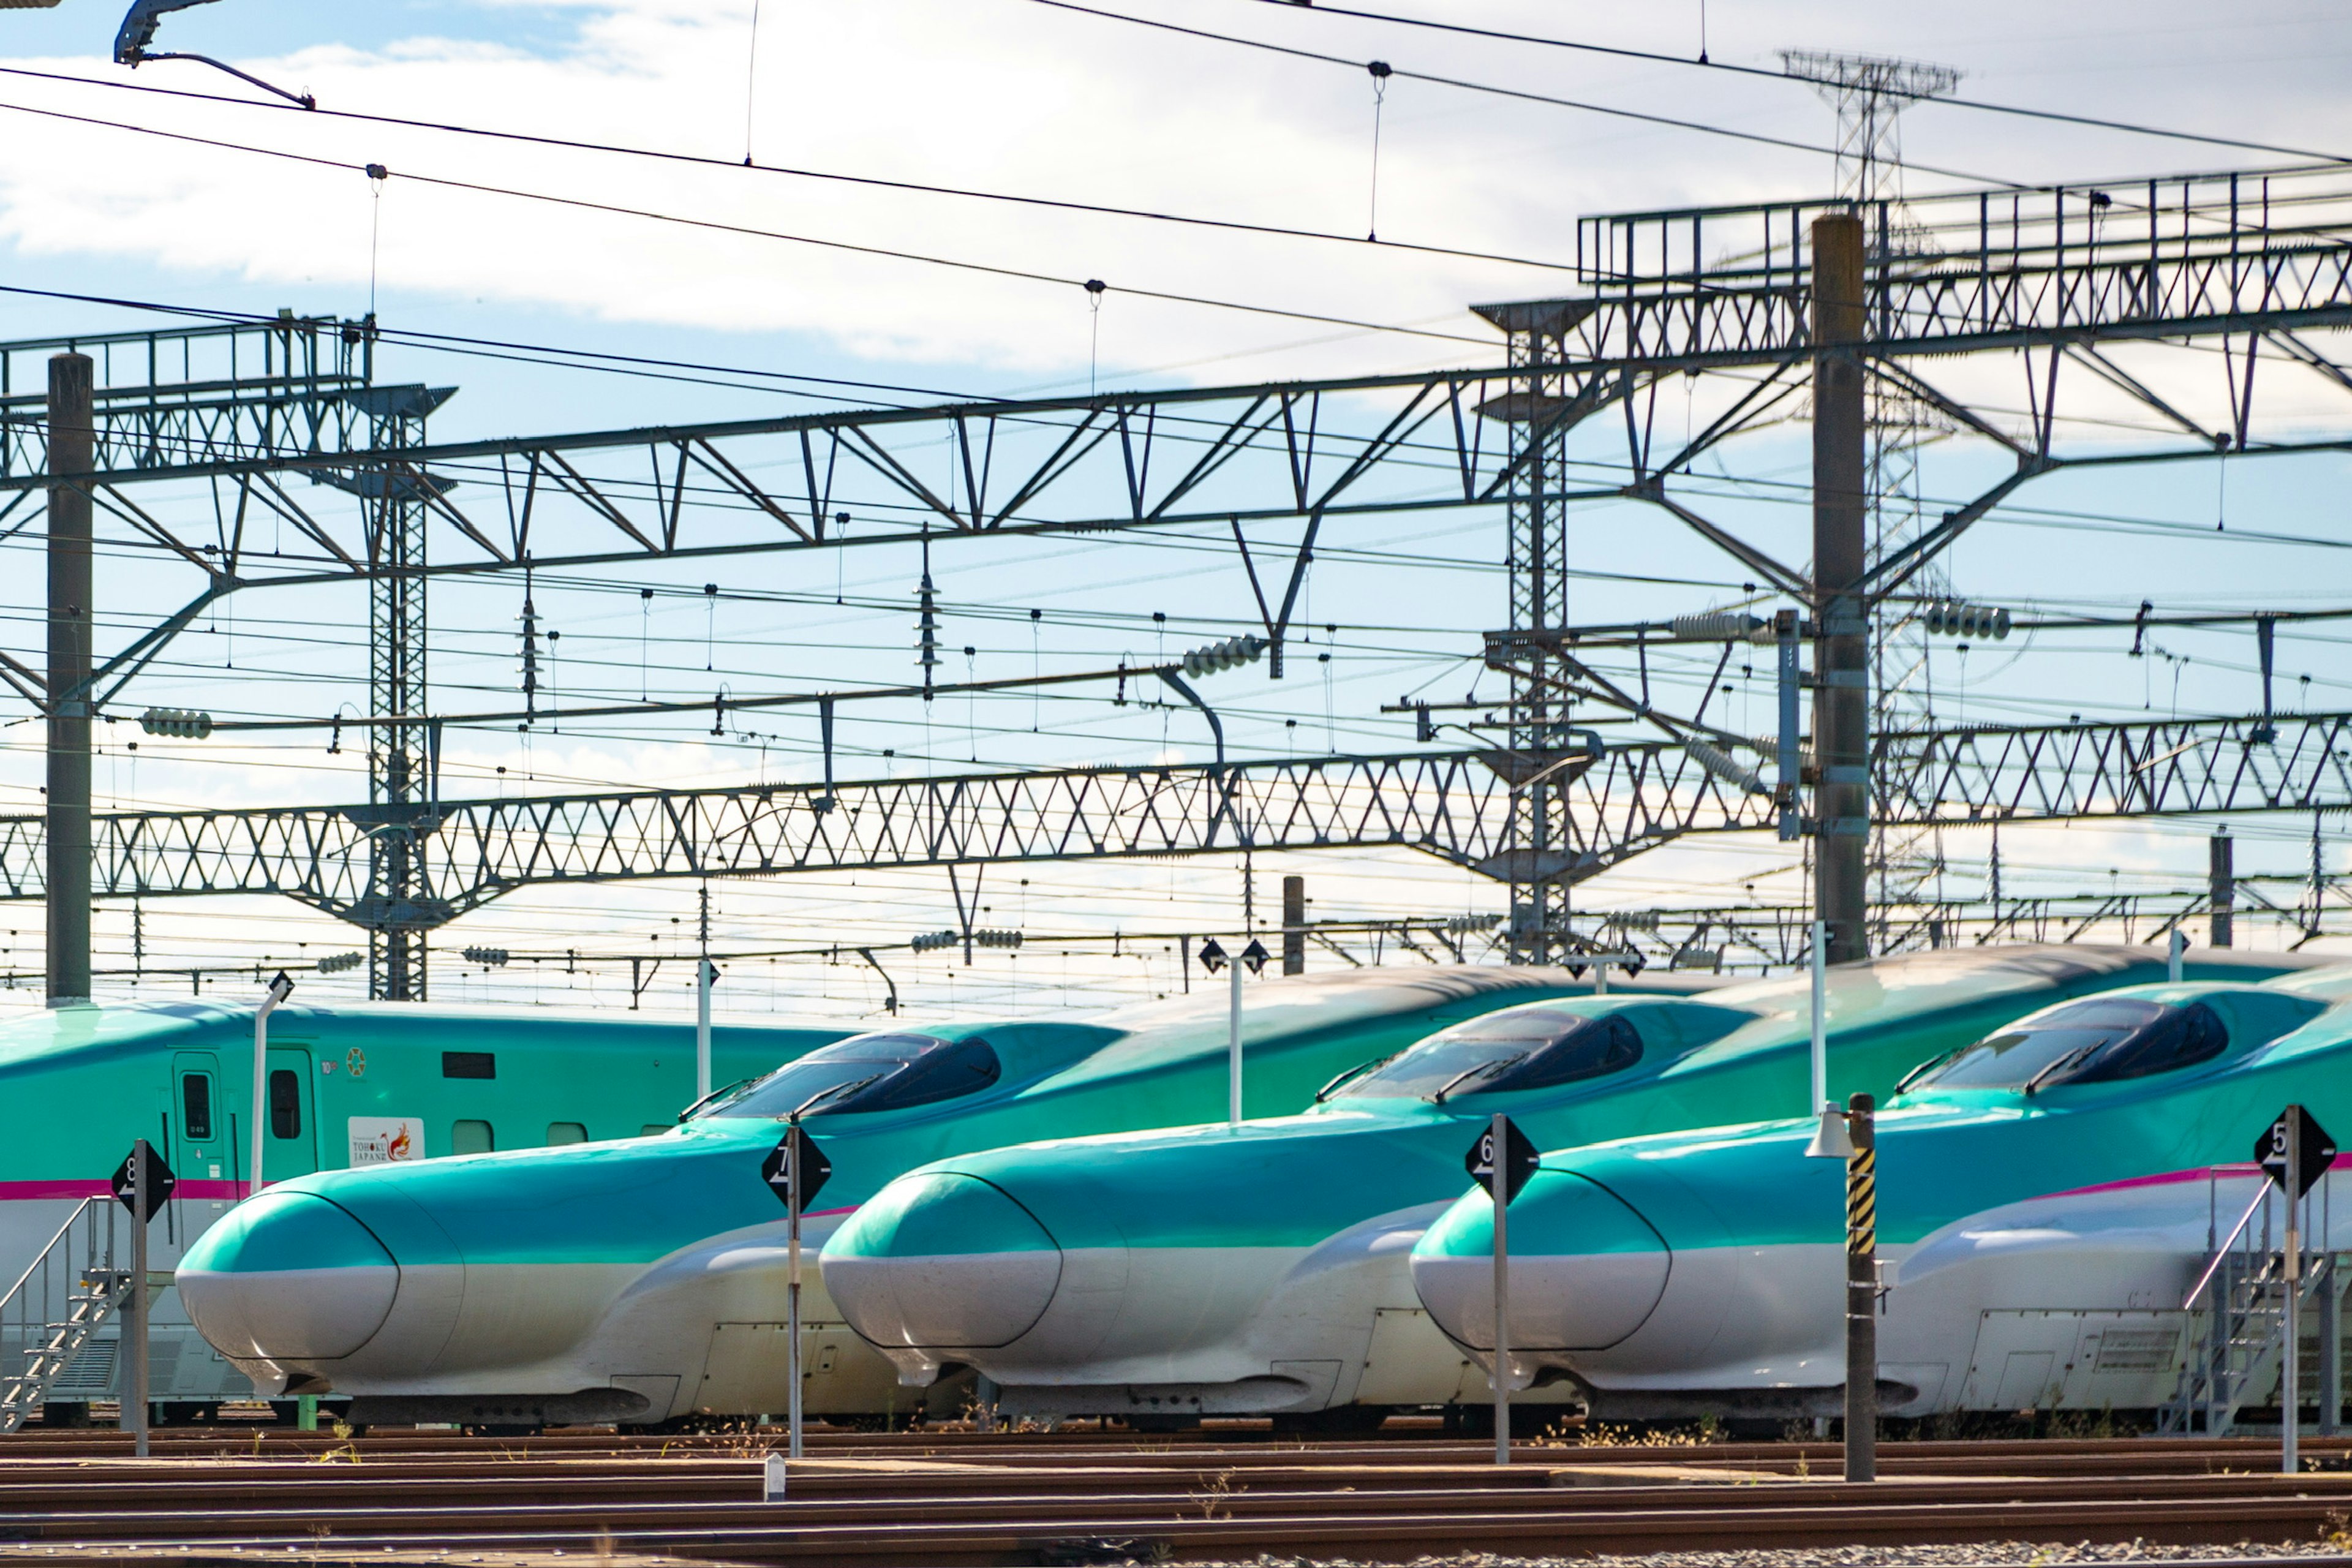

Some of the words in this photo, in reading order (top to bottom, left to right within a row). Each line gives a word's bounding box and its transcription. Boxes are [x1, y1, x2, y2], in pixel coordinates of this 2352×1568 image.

[353, 1142, 386, 1152] TOHOKU
[1482, 1135, 1493, 1162] 6
[2273, 1123, 2286, 1152] 5
[353, 1152, 381, 1161] JAPAN
[777, 1147, 788, 1171] 7
[127, 1157, 135, 1182] 8
